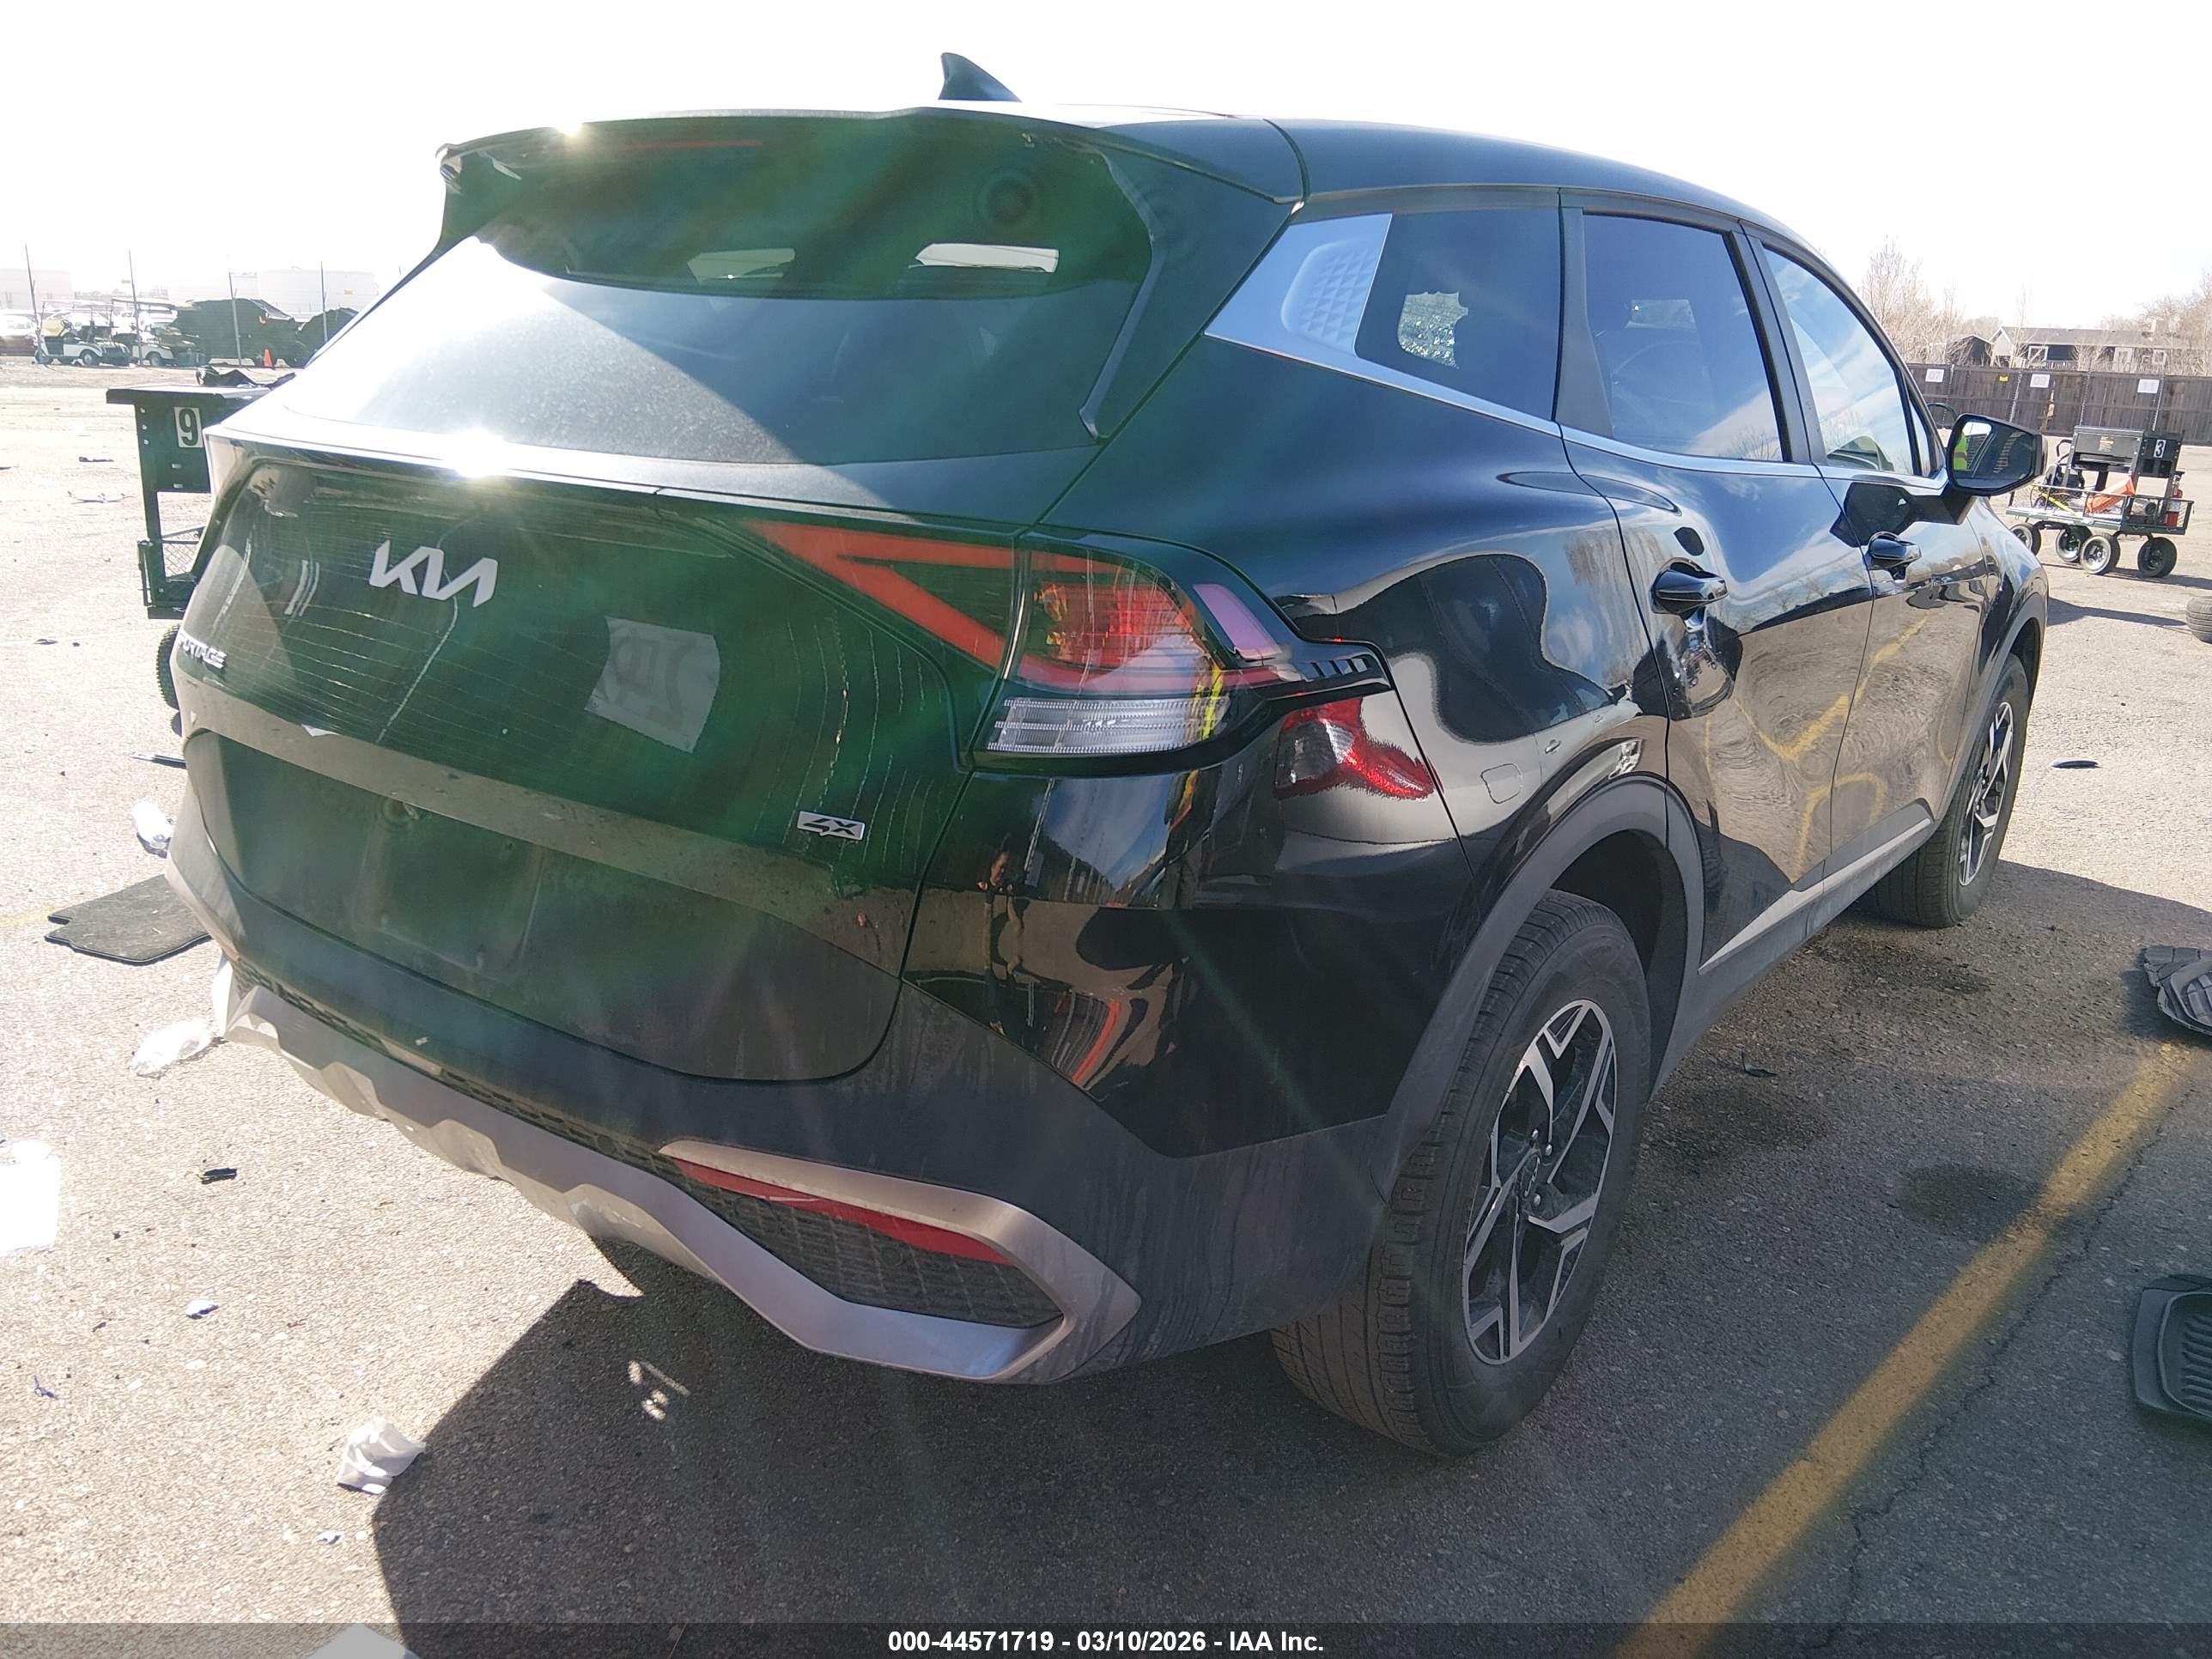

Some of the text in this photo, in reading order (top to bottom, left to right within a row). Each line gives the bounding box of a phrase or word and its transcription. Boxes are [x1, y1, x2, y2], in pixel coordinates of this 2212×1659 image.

[178, 408, 199, 447] 9
[2154, 440, 2165, 457] 3
[369, 539, 499, 608] KIA
